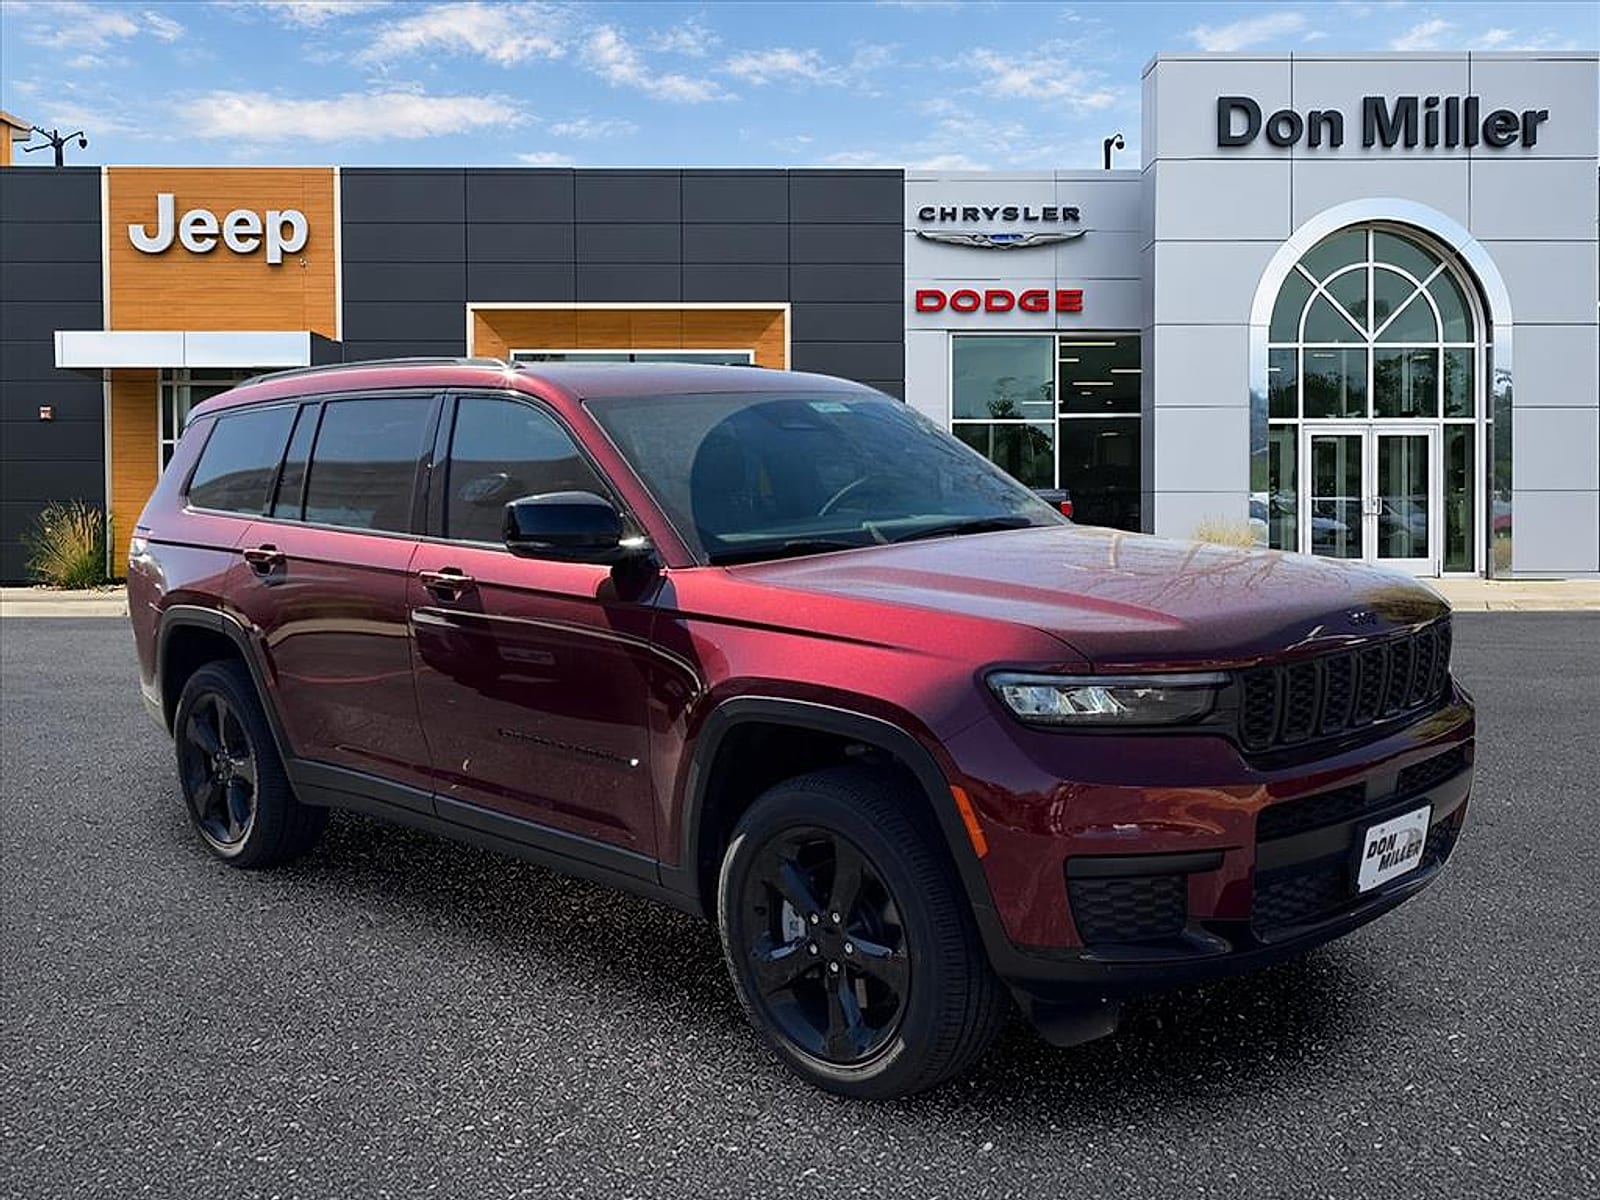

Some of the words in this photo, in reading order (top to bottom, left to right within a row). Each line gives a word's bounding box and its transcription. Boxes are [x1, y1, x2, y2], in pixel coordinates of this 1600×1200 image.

[1217, 96, 1344, 148] Don
[1362, 96, 1549, 148] Miller
[128, 193, 308, 264] Jeep
[918, 207, 1081, 222] CHRYSLER
[916, 289, 1083, 312] DODGE
[1366, 833, 1398, 859] DON
[1378, 840, 1422, 872] MILLER
